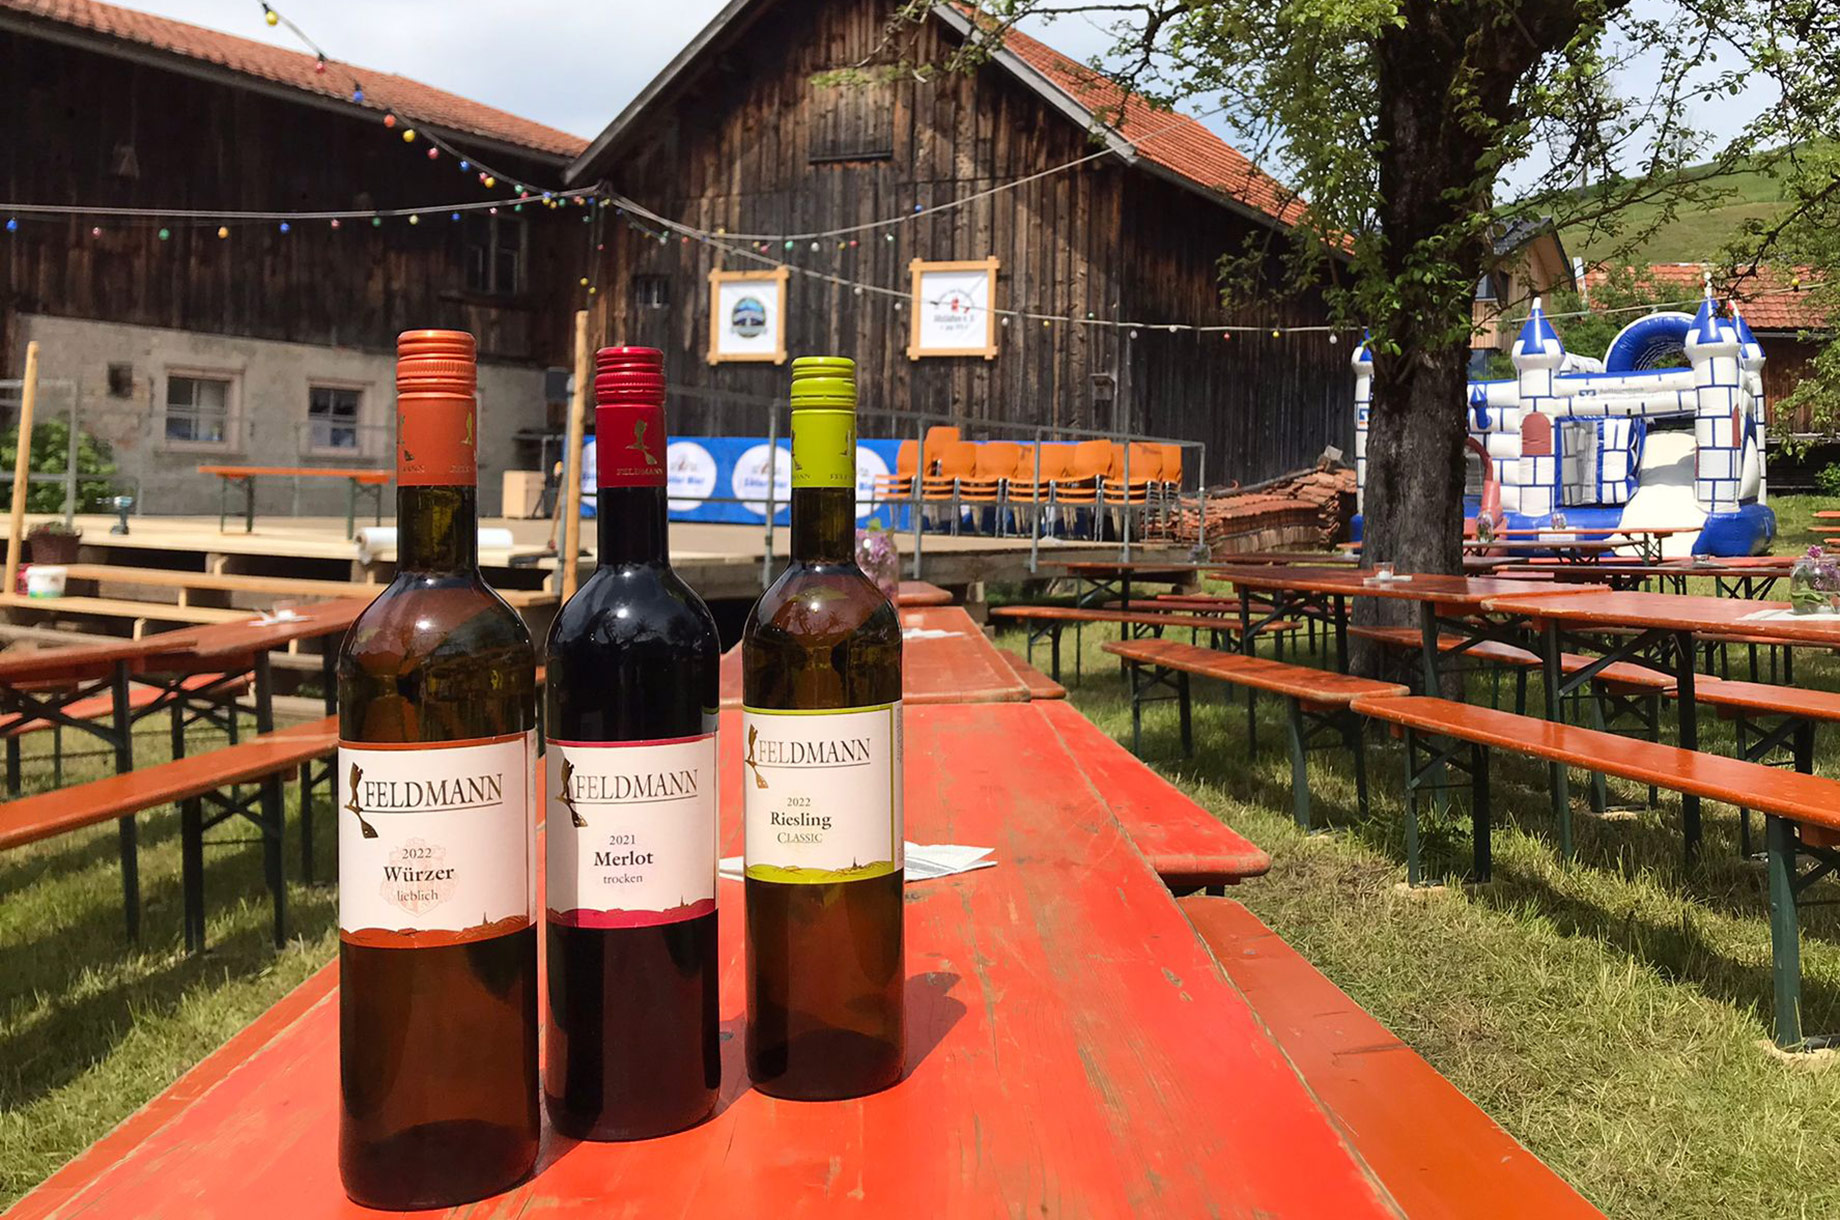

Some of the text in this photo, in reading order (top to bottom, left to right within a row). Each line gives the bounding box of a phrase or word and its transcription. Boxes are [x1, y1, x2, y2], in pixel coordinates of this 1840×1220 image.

[757, 738, 871, 764] FELDMANN
[364, 773, 503, 808] FELDMANN
[575, 769, 699, 799] FELDMANN
[787, 797, 811, 807] 2022
[770, 811, 832, 830] Riesling
[609, 834, 636, 845] 2021
[777, 831, 823, 844] CLASSIC
[402, 848, 432, 859] 2022
[594, 851, 654, 866] Merlot
[384, 865, 455, 882] Würzer
[603, 873, 643, 884] trocken
[397, 889, 439, 901] lieblich
